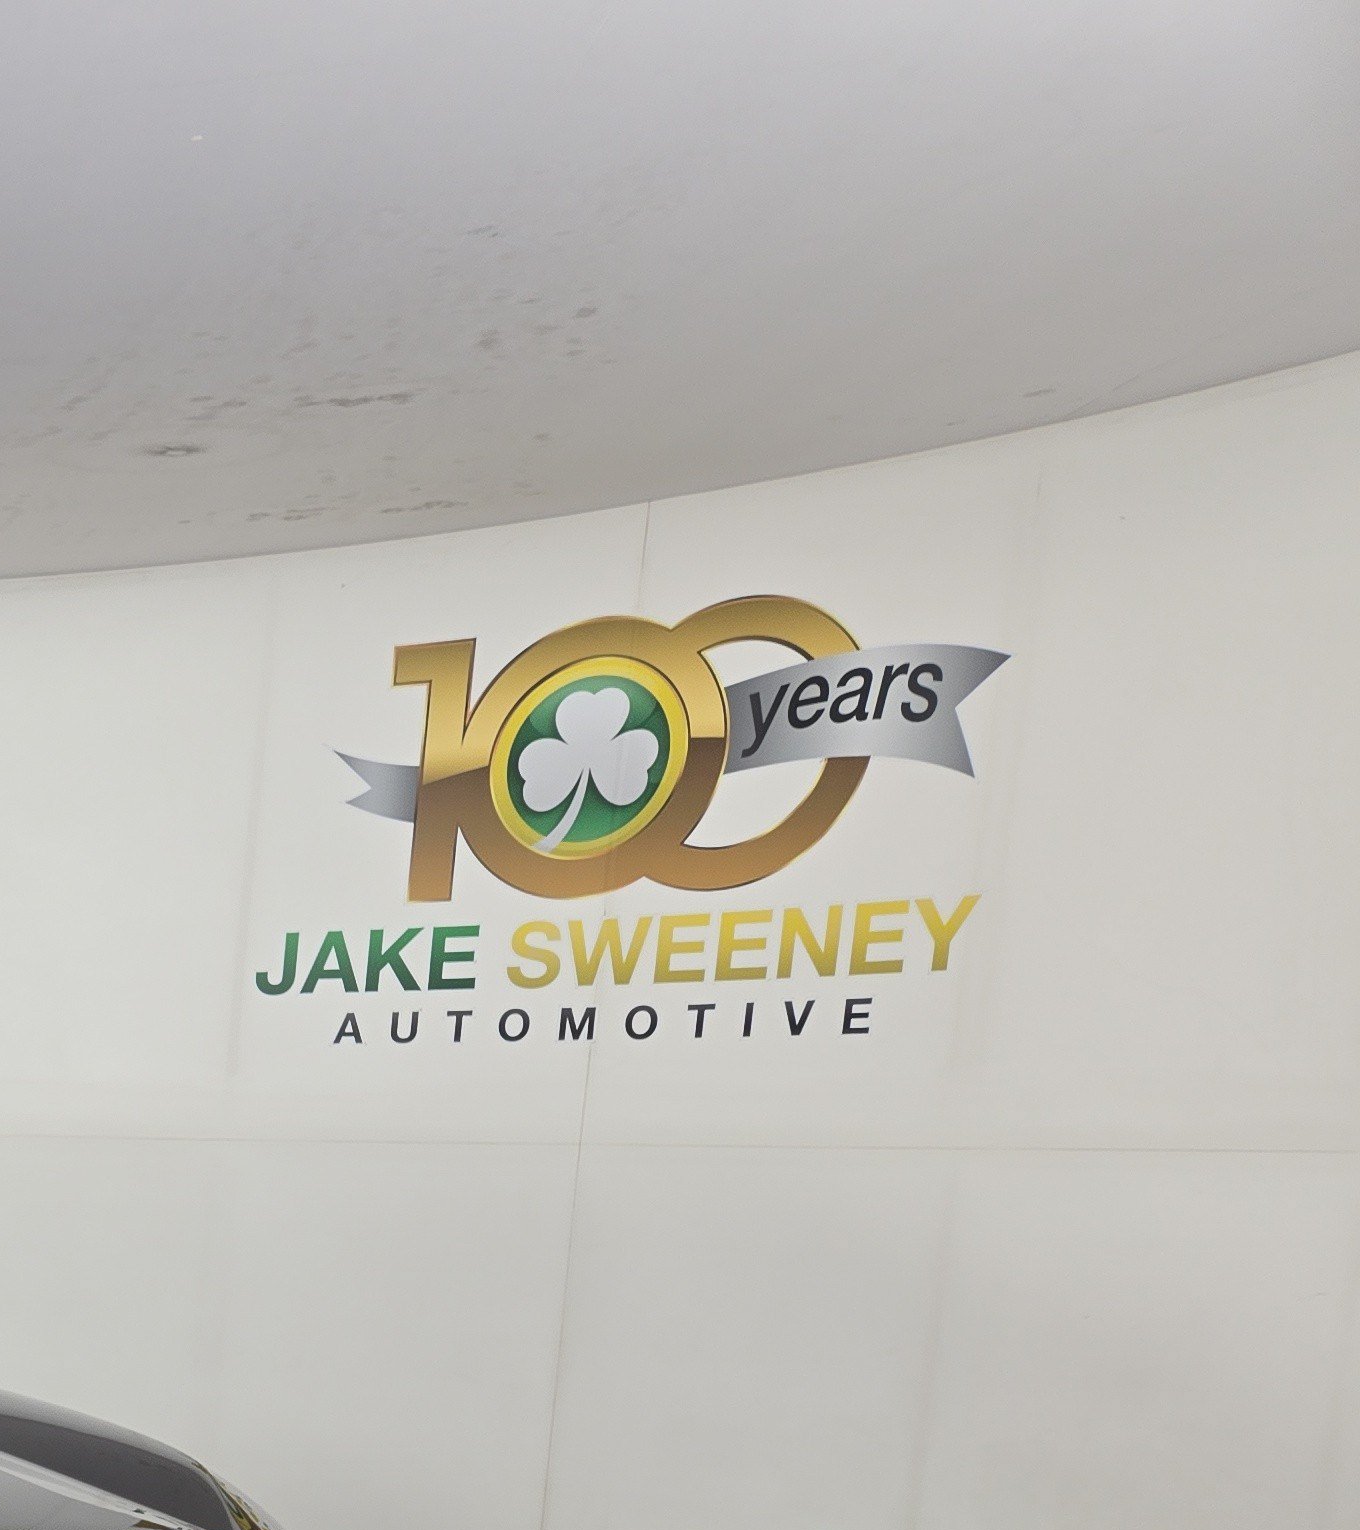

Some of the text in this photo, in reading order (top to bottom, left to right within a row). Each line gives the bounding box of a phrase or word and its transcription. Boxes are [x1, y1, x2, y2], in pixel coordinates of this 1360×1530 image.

[393, 595, 944, 903] 100 years
[256, 894, 982, 995] JAKE SWEENEY
[333, 998, 874, 1044] AUTOMOTIVE
